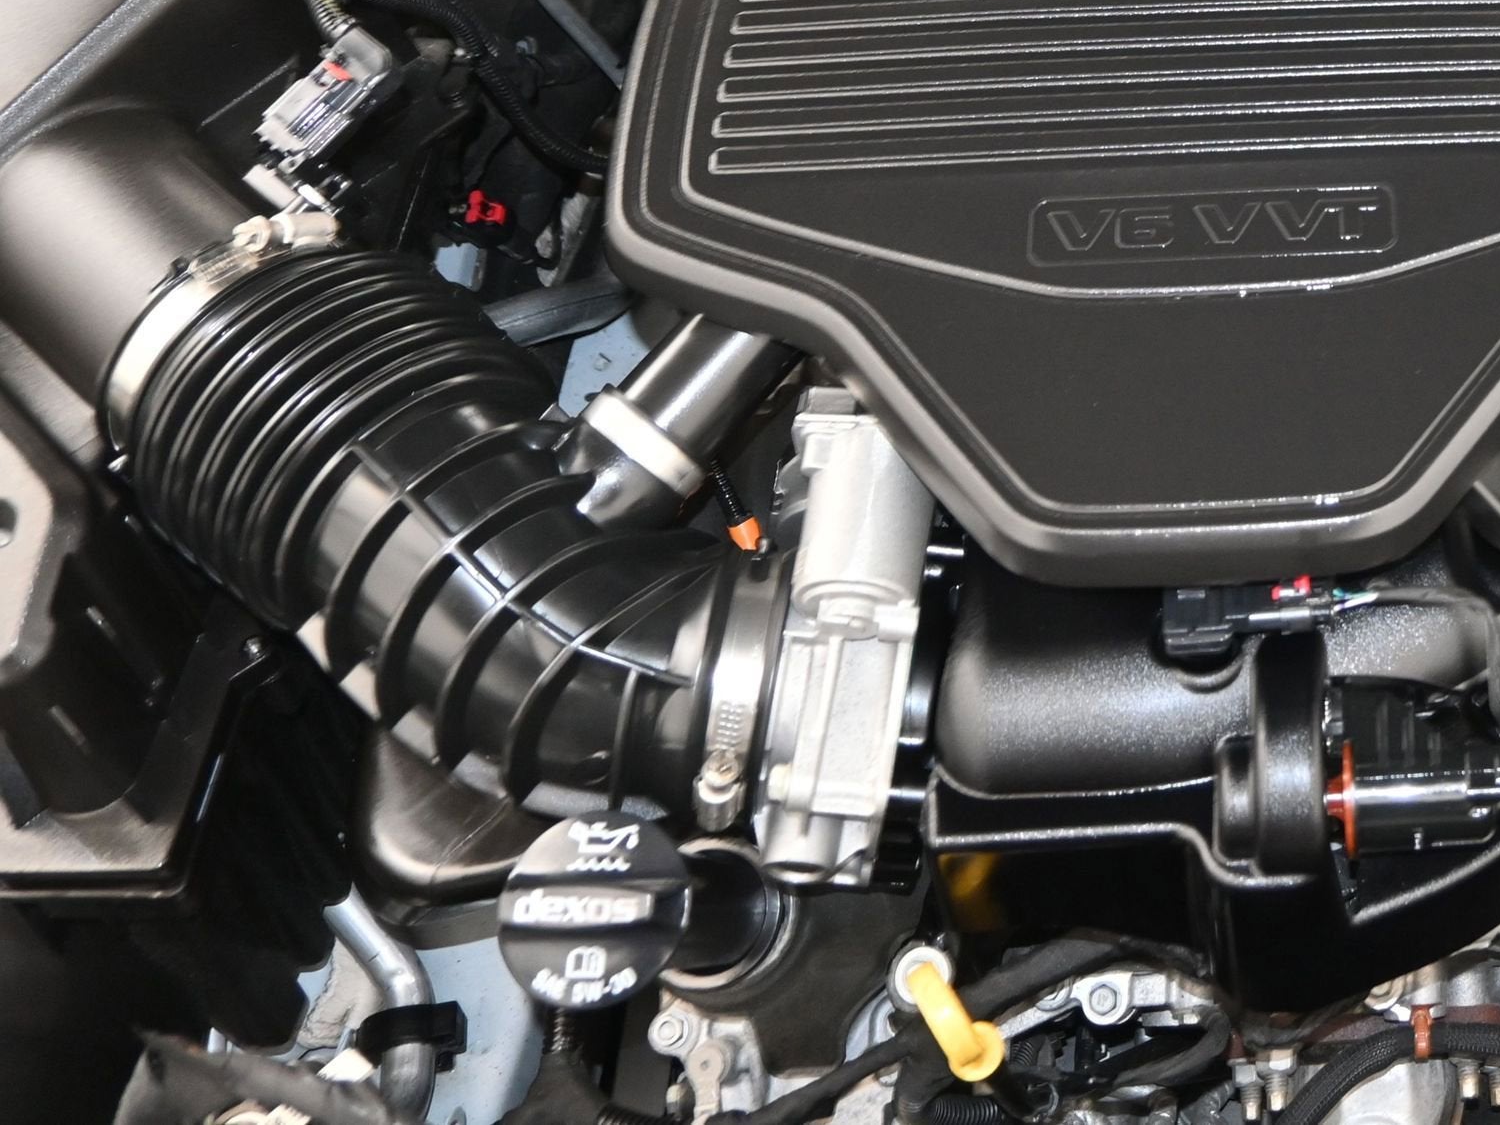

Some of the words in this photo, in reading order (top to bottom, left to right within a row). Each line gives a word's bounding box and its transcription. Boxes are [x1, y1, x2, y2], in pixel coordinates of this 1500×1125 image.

[1047, 206, 1175, 252] V6
[1193, 196, 1380, 245] VVT
[512, 888, 641, 923] dexos
